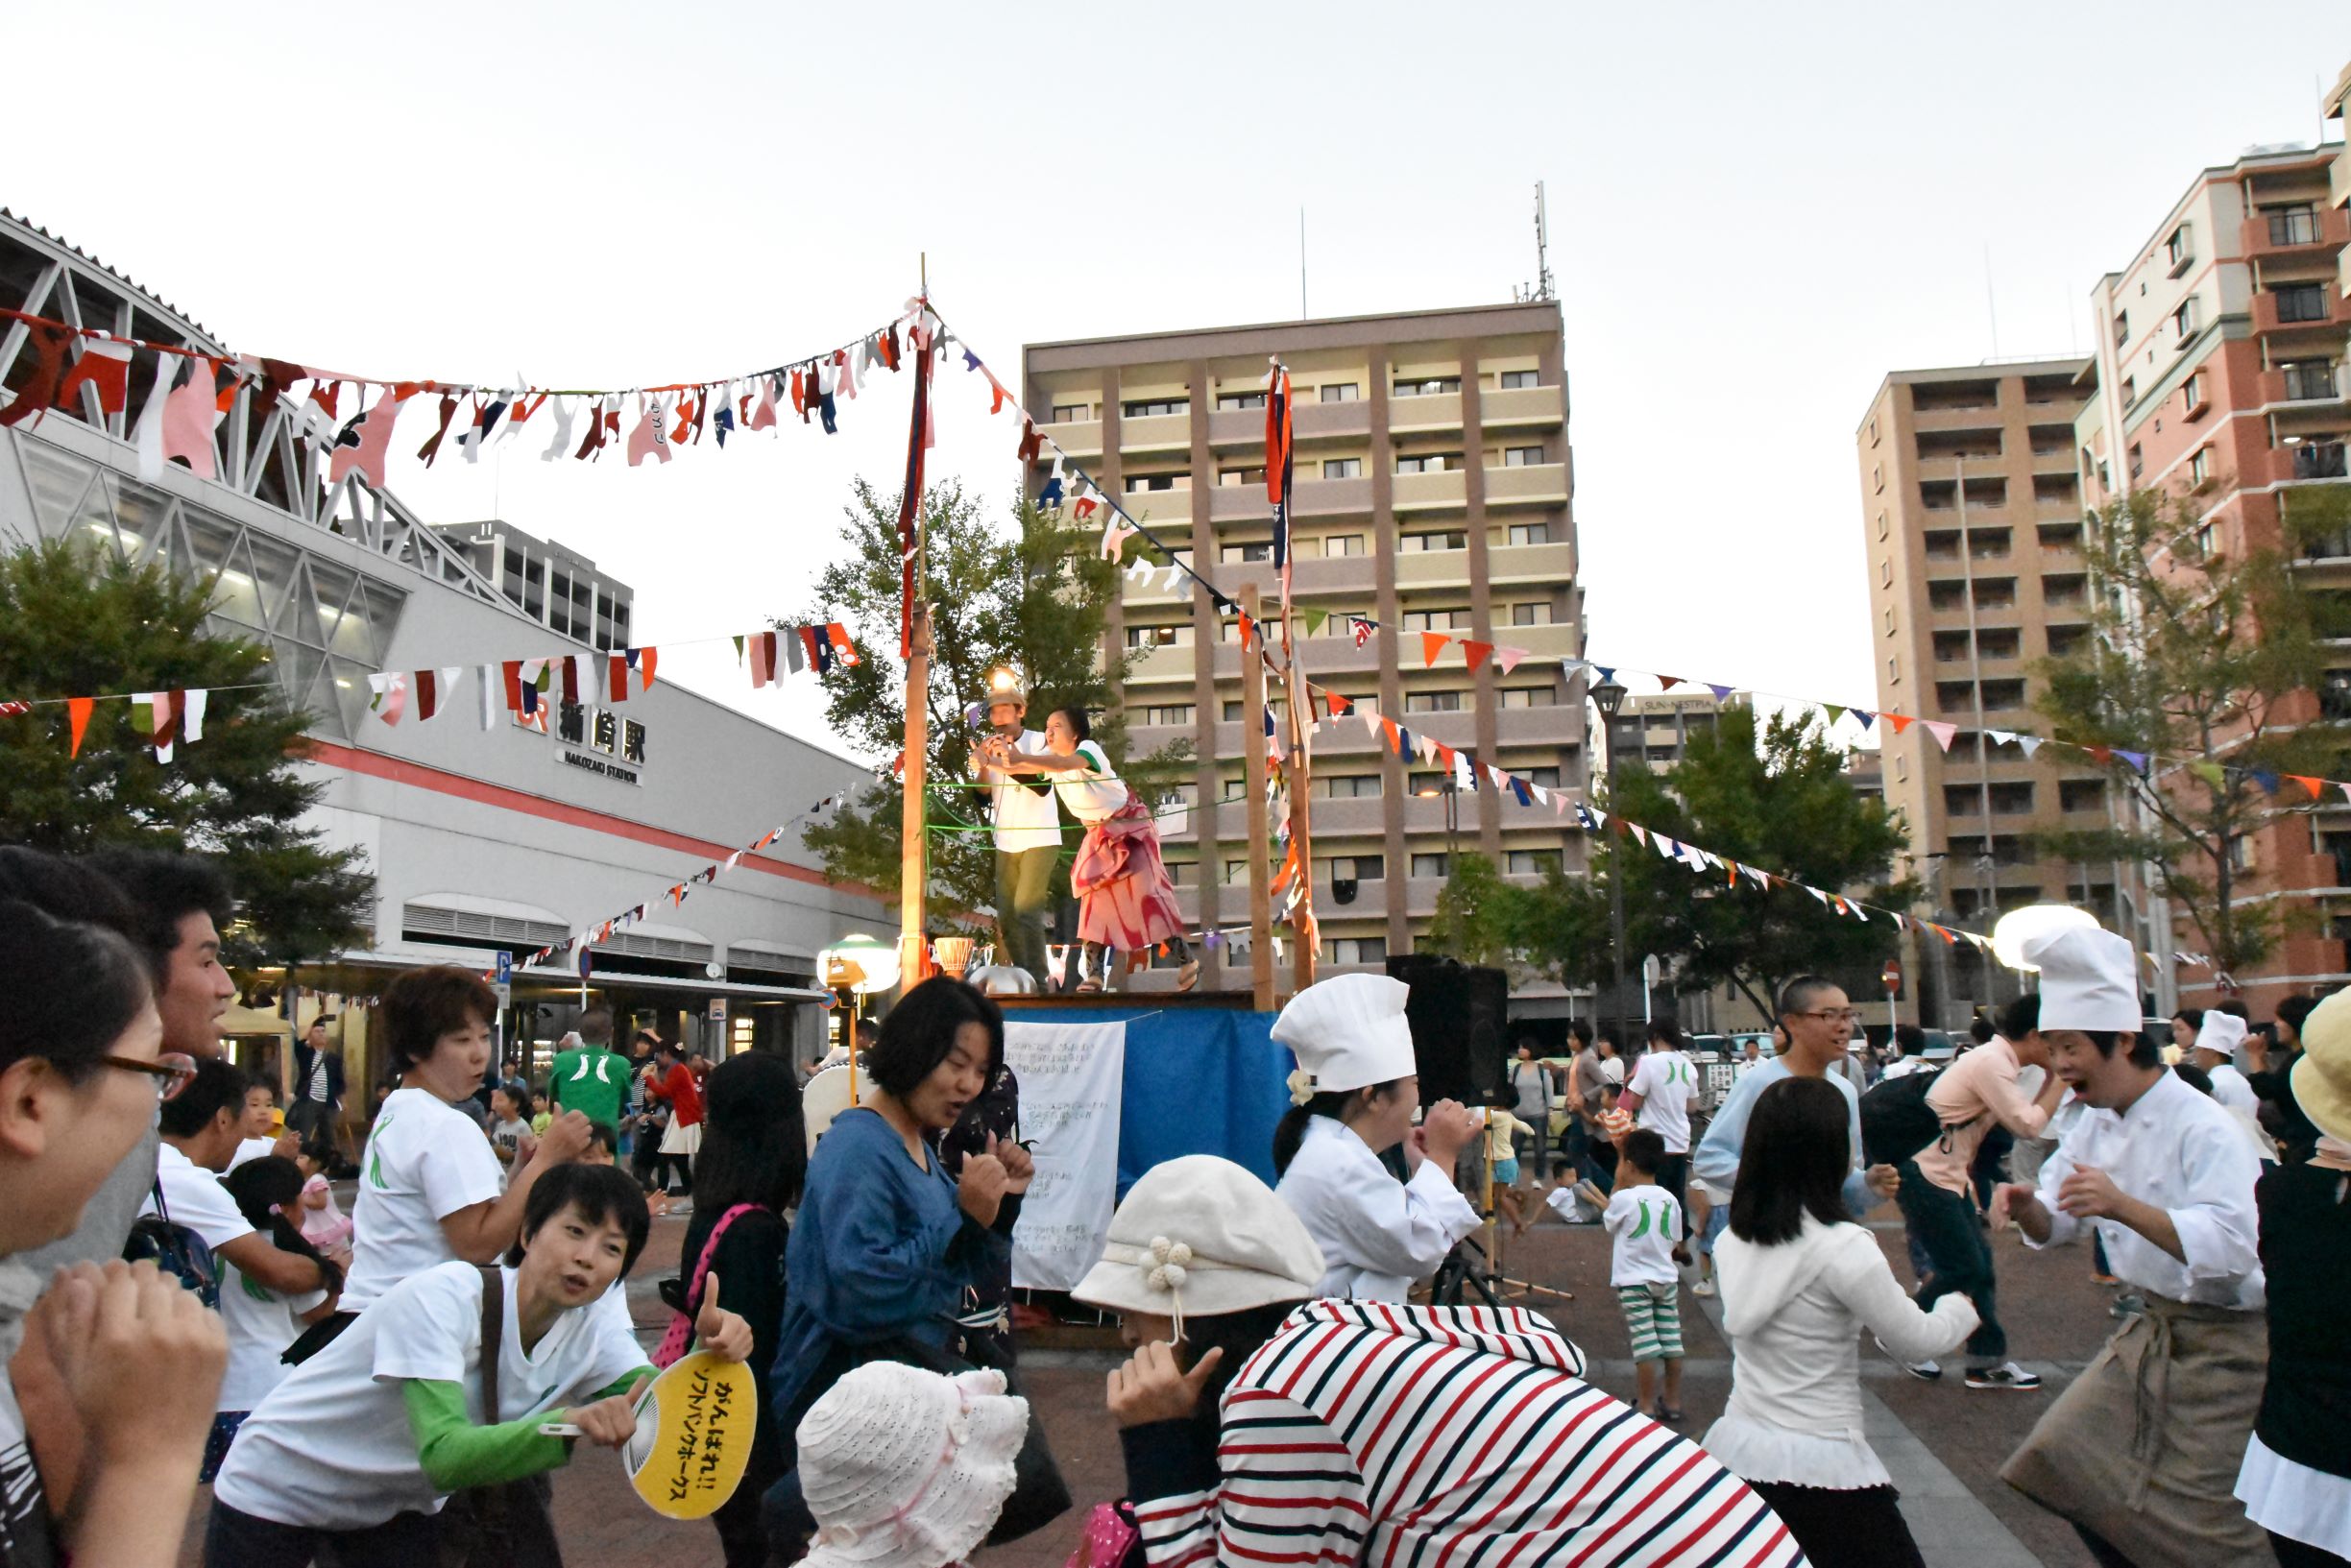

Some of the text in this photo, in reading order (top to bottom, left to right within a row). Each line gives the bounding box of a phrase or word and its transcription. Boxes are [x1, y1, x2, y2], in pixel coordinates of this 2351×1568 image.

[607, 764, 637, 784] STATION
[668, 1367, 710, 1501] ソフトバンクホークス
[696, 1382, 733, 1490] がんばれ!!
